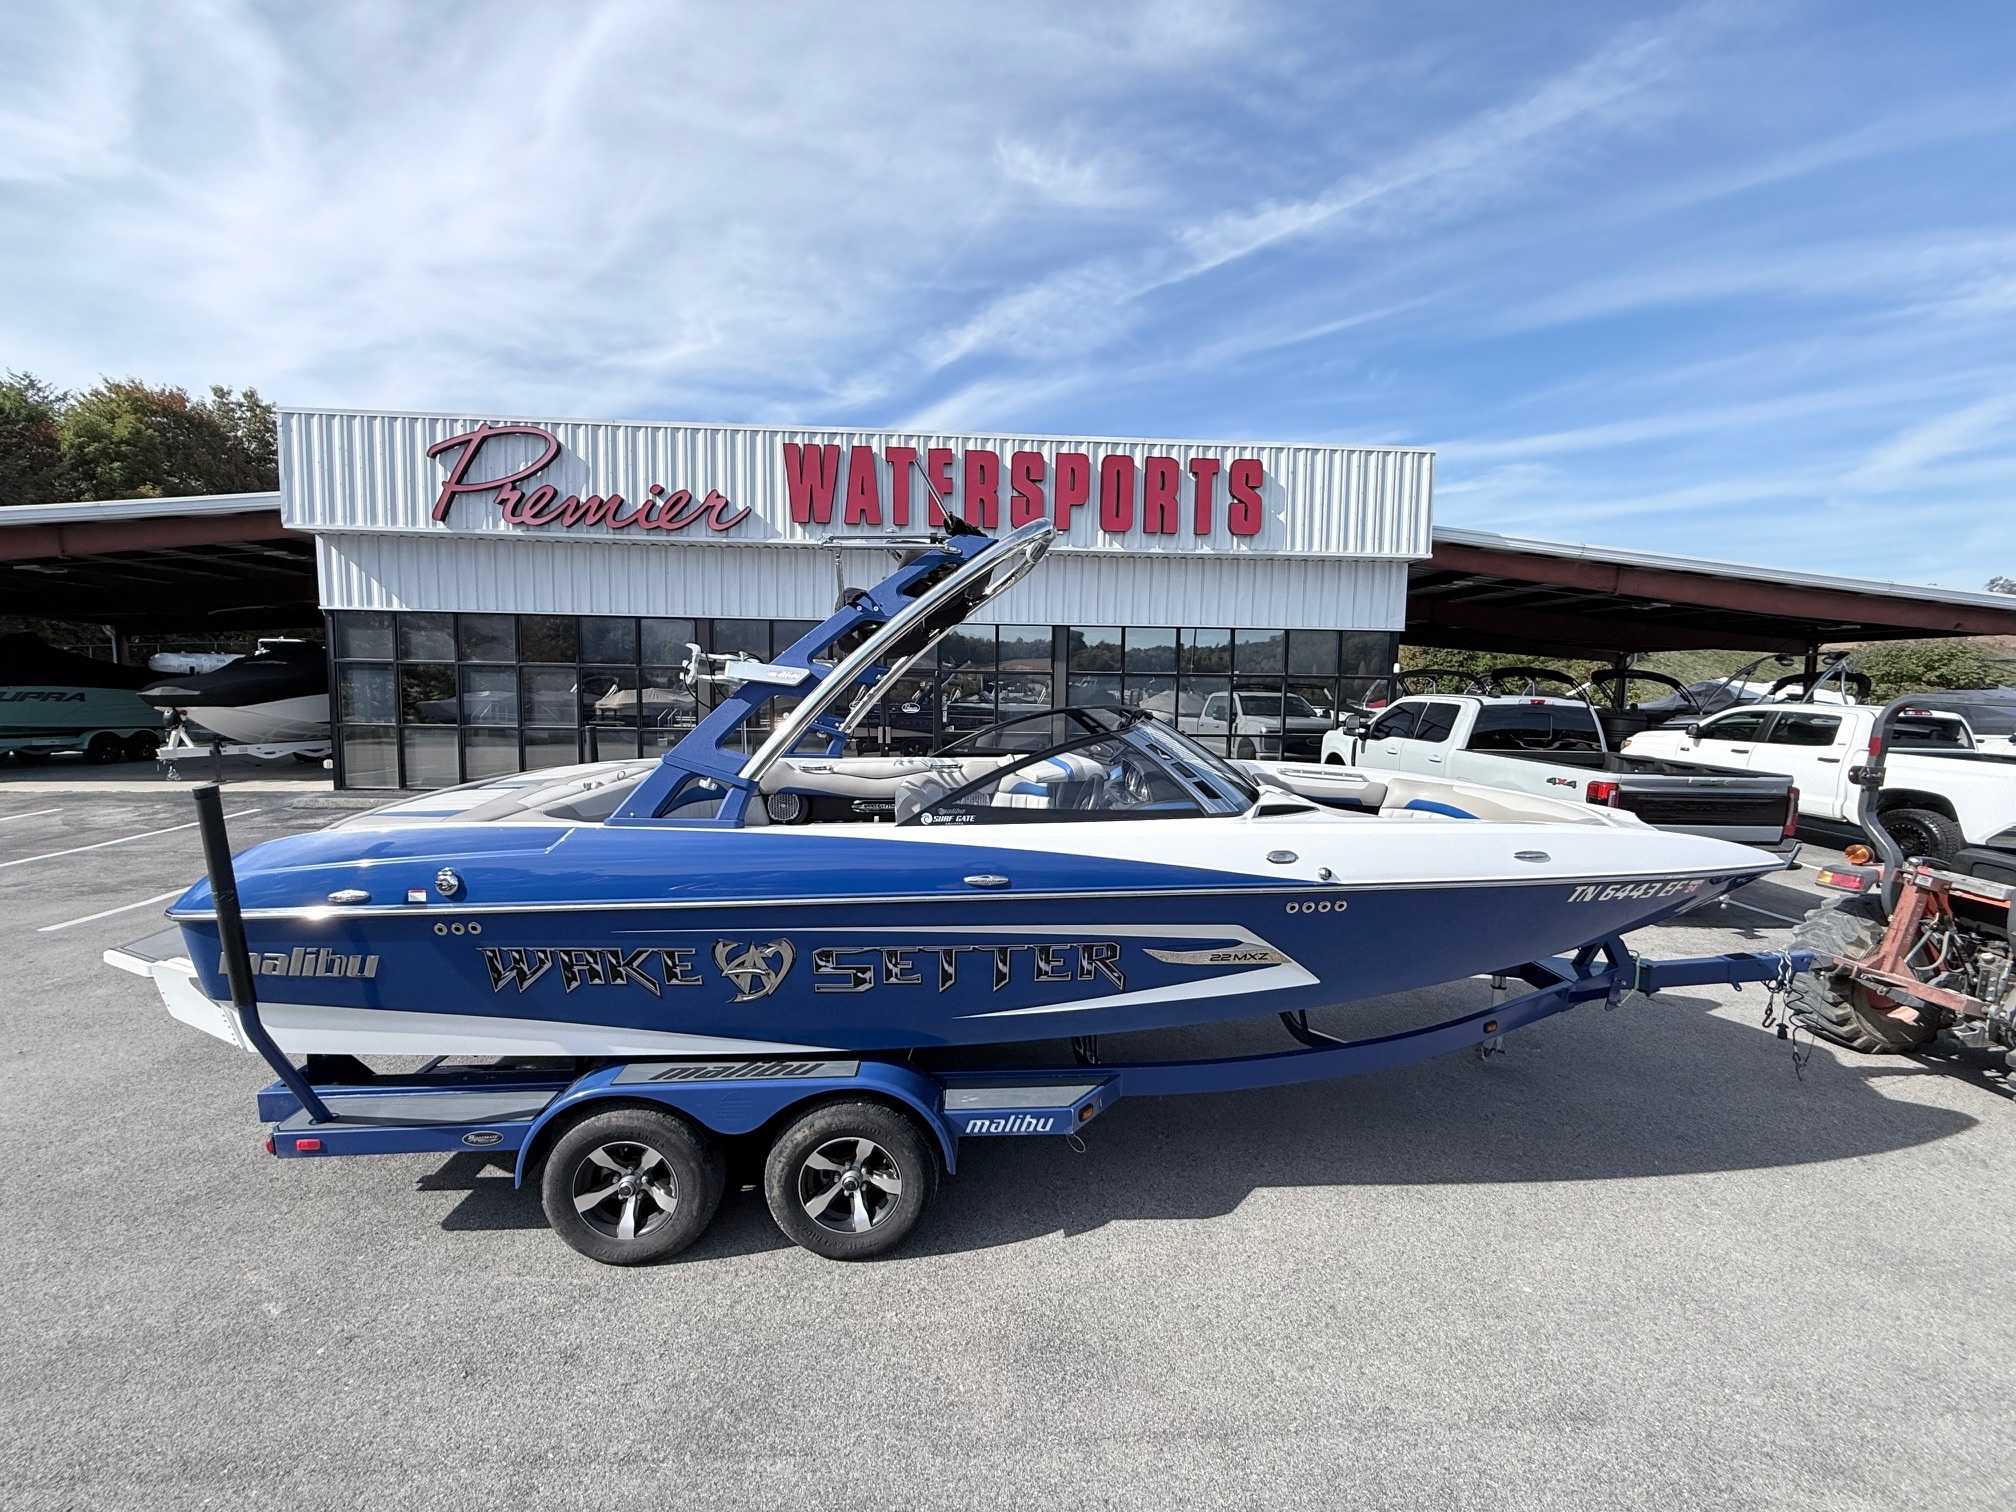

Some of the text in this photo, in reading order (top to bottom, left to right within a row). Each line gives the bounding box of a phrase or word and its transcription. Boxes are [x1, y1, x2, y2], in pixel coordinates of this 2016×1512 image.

[427, 423, 1264, 536] Premier WATERSPORTS
[933, 814, 976, 823] SURF GATE
[1567, 885, 1602, 903] TN
[1598, 883, 1660, 902] 6443
[475, 942, 1125, 997] WAKE SETTER
[648, 1061, 826, 1081] malibu
[965, 1114, 1055, 1134] malibu
